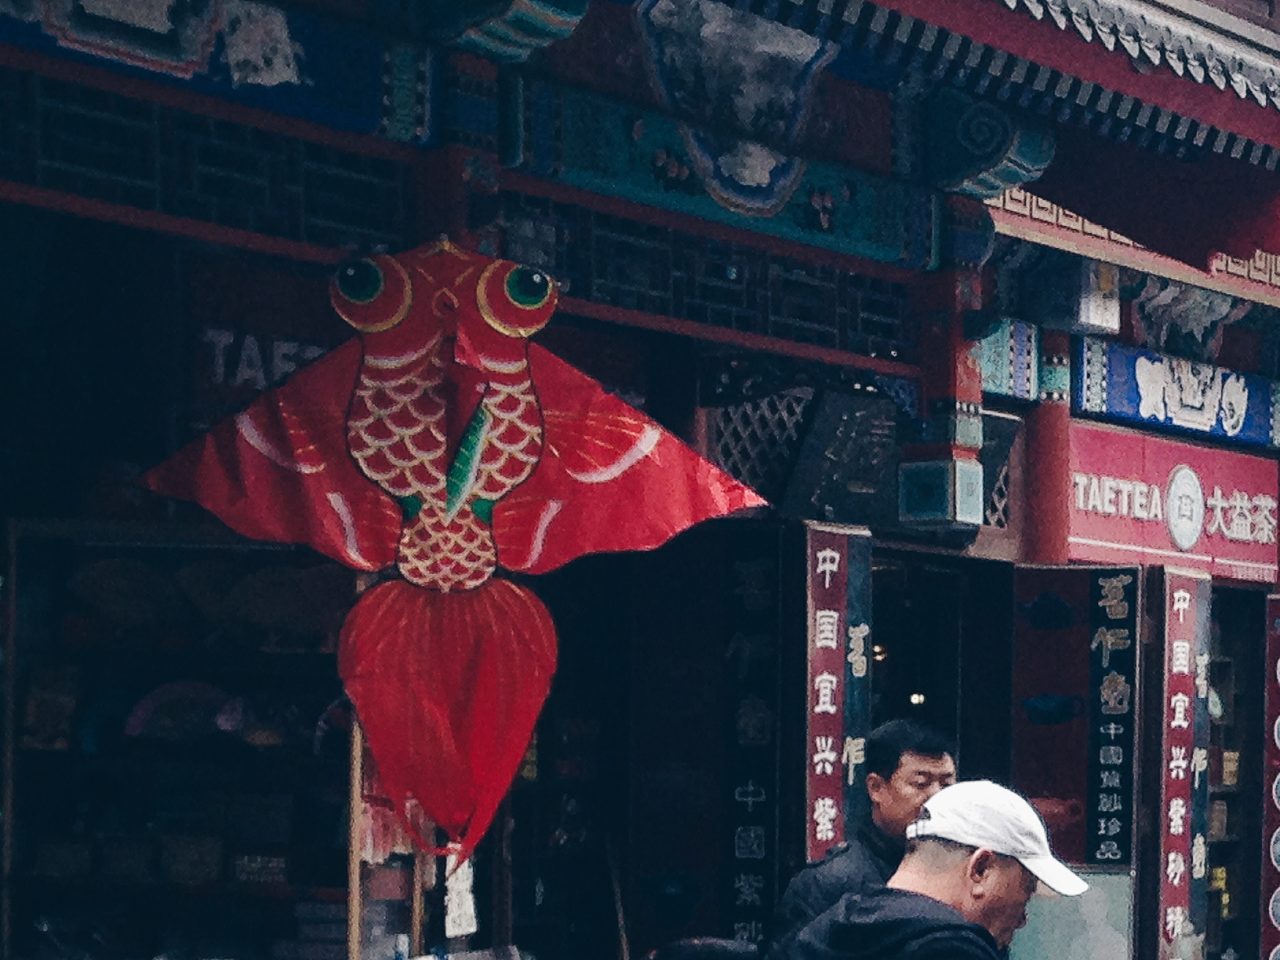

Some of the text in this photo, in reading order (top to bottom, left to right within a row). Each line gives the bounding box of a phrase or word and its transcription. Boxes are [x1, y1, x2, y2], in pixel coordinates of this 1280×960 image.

[1072, 472, 1163, 522] TAETEA
[1207, 486, 1277, 543] 大益茶
